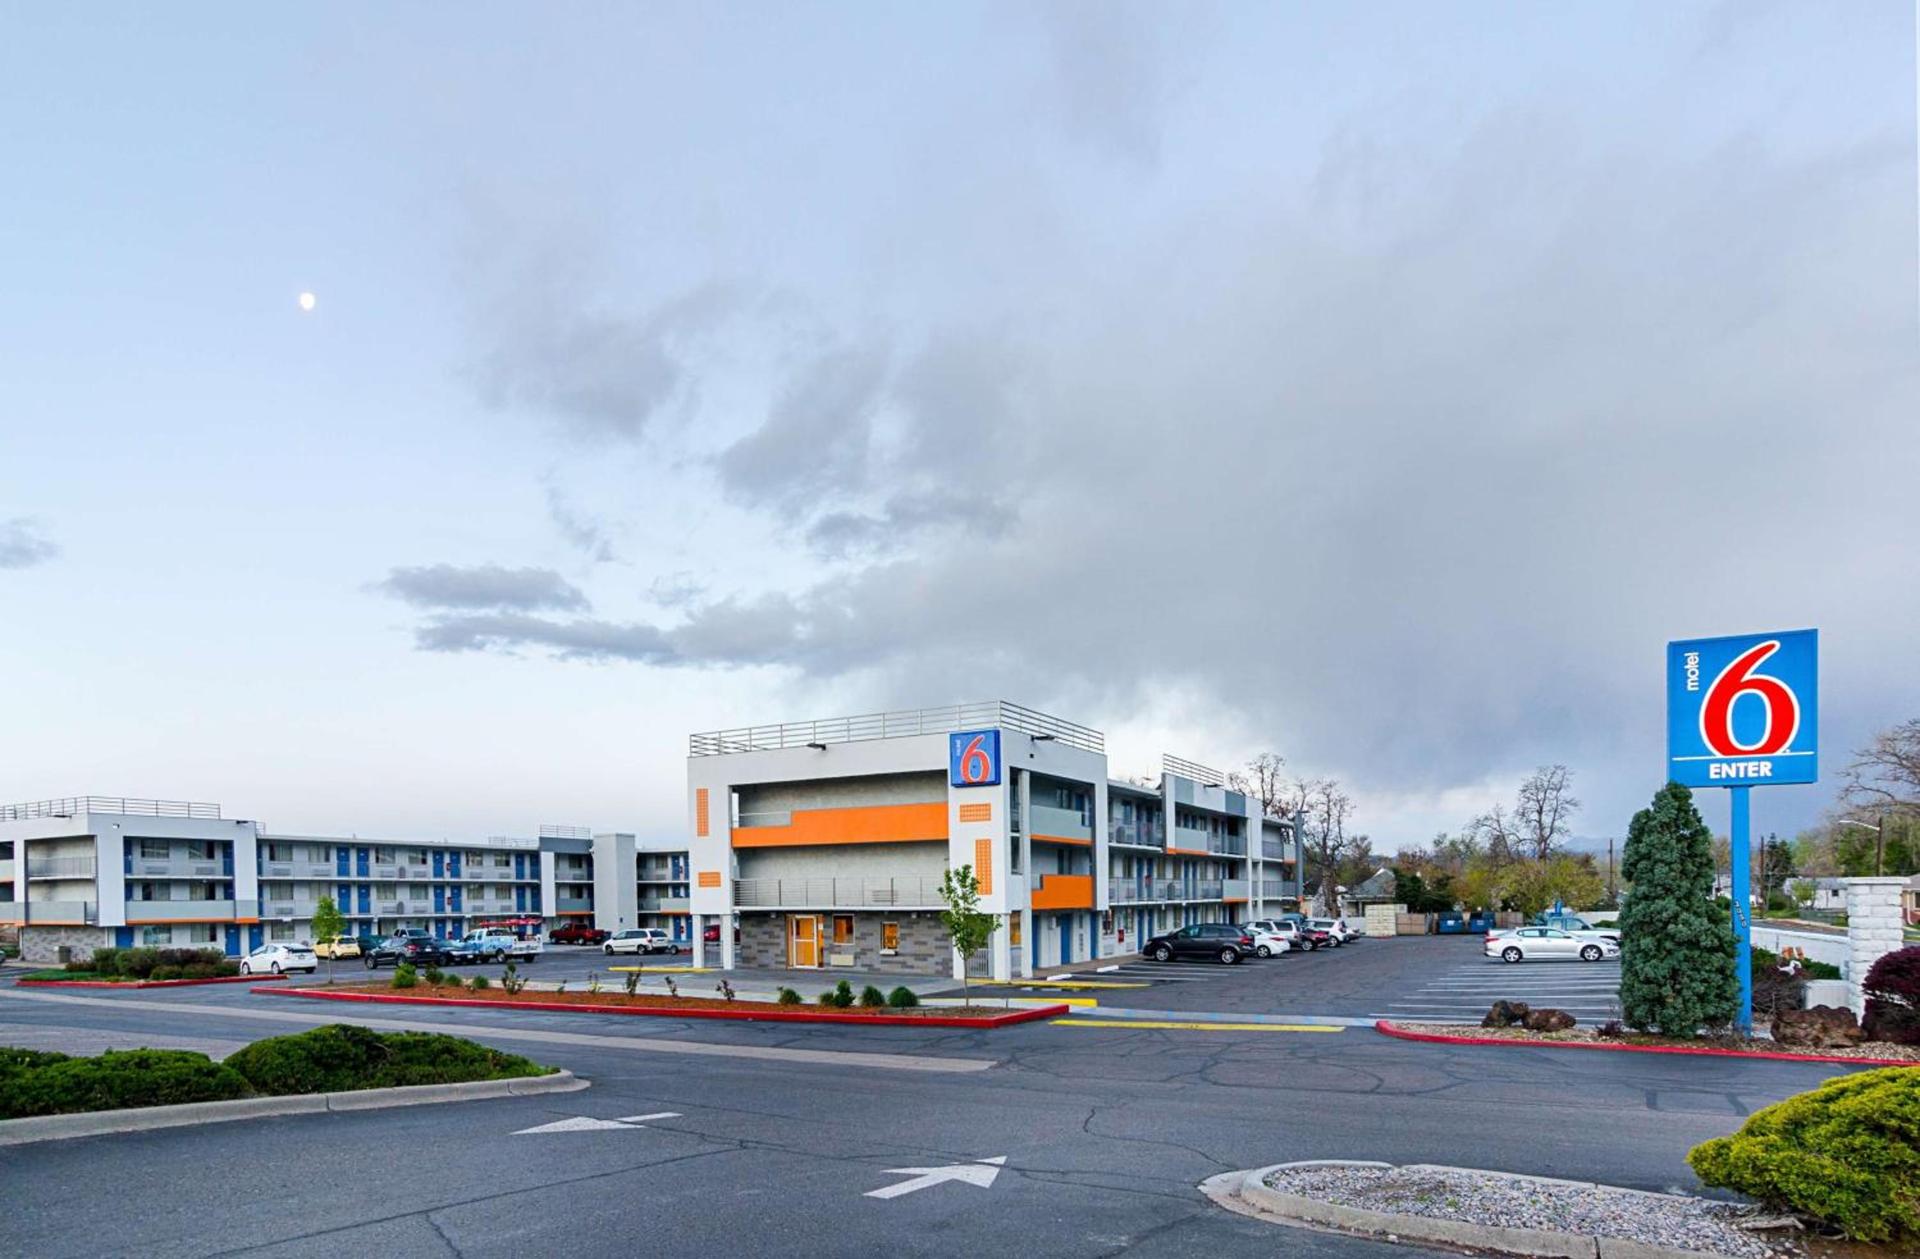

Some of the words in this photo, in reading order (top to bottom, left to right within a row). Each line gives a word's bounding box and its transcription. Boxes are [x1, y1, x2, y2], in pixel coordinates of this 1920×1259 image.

[1684, 652, 1699, 690] motel
[1699, 640, 1800, 757] 6
[960, 735, 991, 784] 6
[1709, 761, 1772, 779] ENTER
